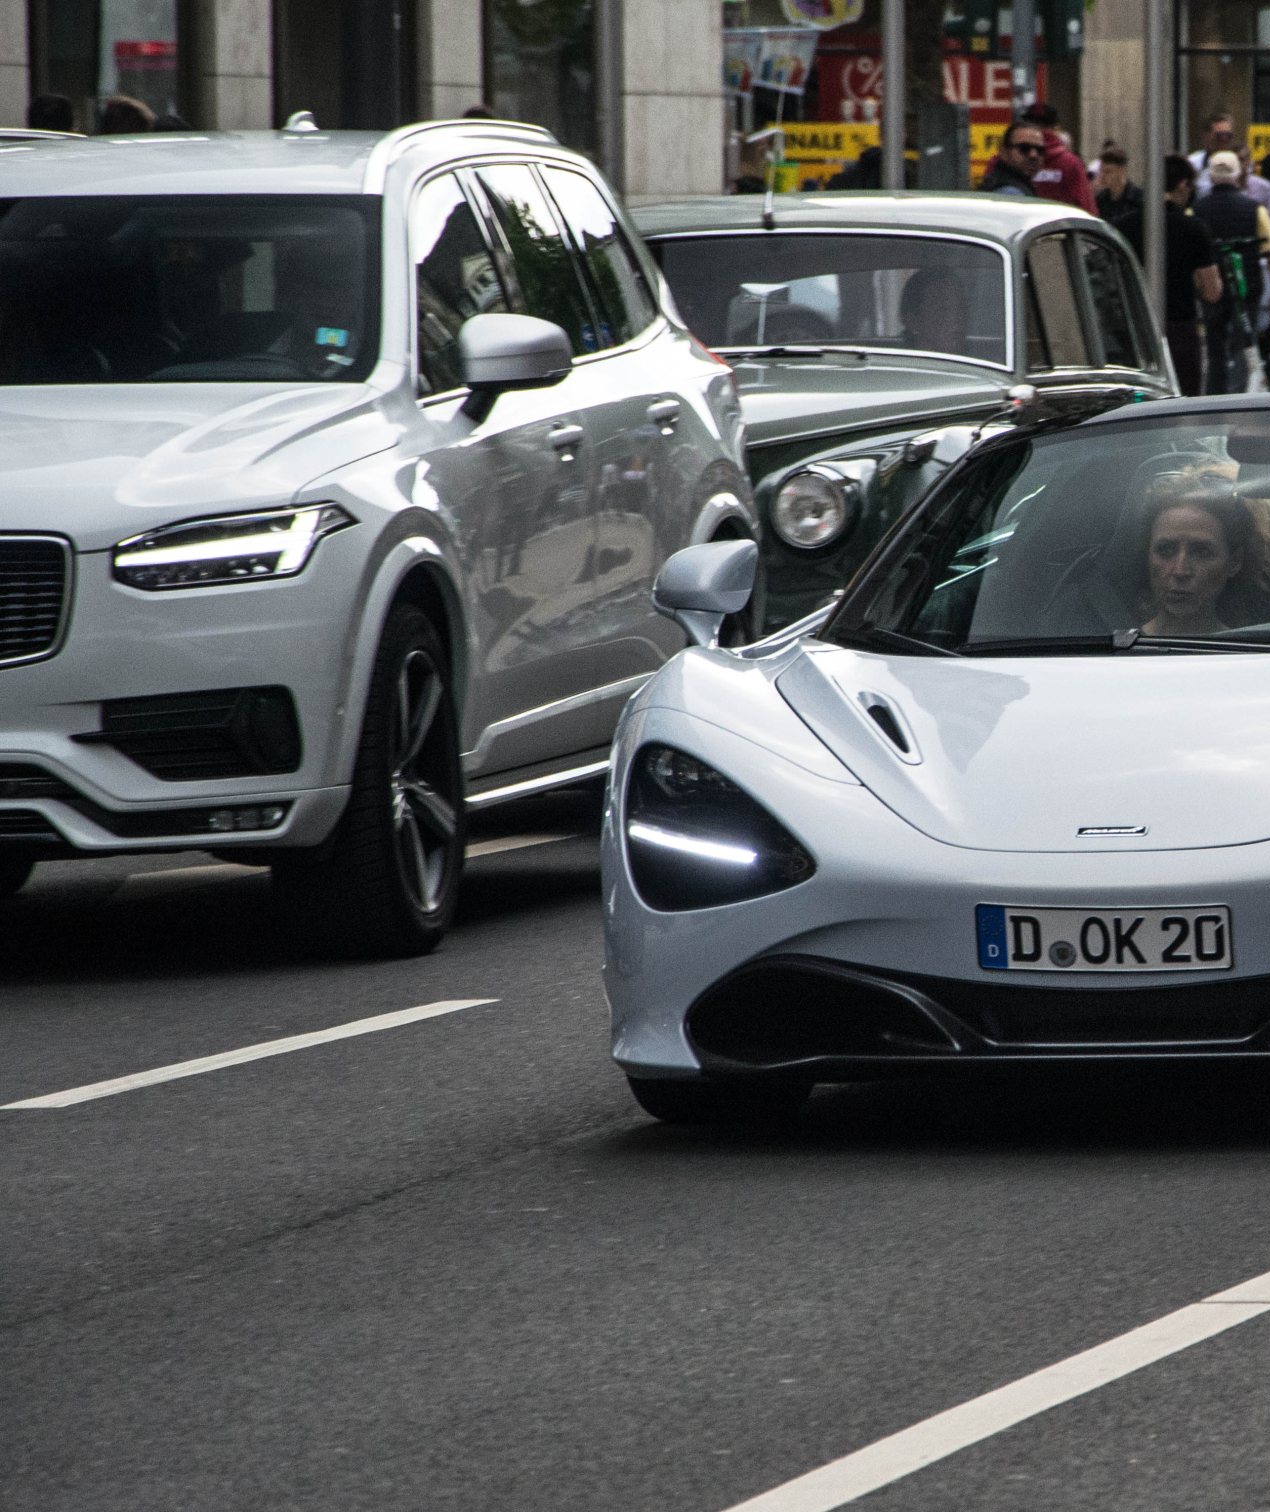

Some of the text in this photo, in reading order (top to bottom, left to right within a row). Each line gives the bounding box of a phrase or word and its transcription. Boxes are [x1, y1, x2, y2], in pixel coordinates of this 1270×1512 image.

[1009, 914, 1225, 964] D OK 20
